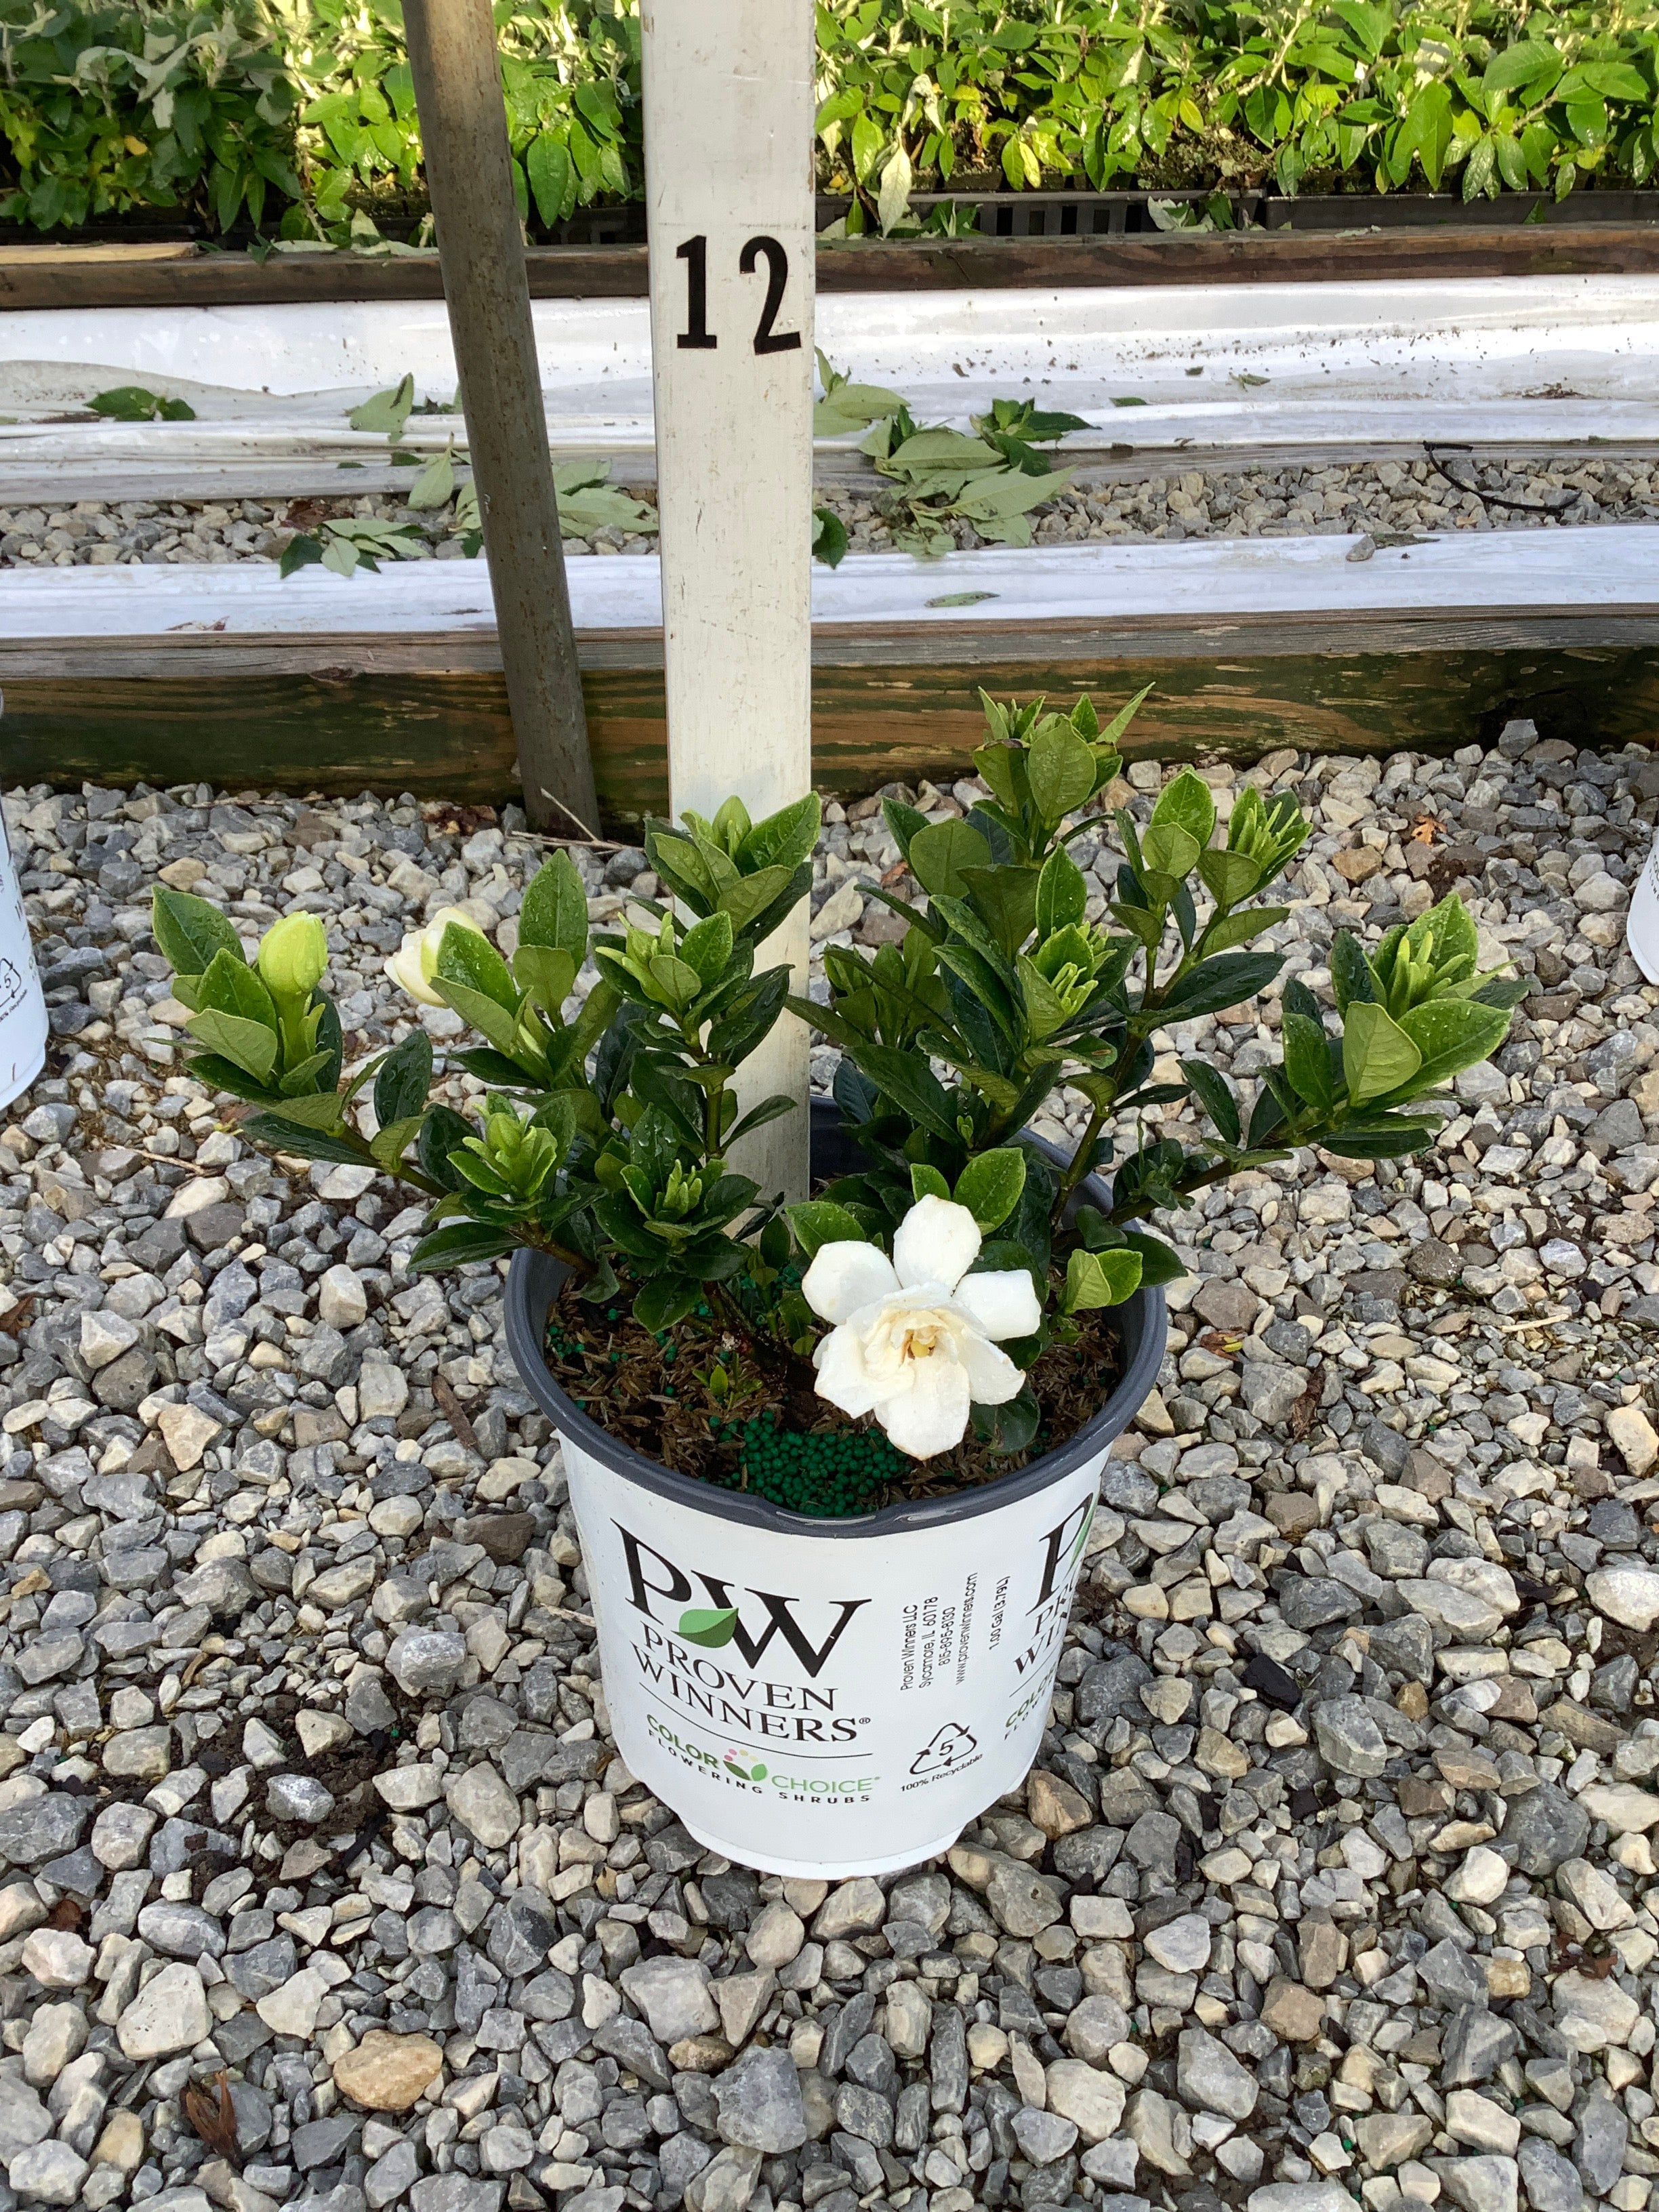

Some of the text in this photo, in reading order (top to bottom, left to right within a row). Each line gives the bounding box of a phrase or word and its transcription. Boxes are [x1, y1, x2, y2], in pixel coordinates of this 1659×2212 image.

[676, 234, 802, 356] 12
[922, 1597, 938, 1626] 60178
[938, 1606, 956, 1666] 815-895-8130
[989, 1576, 1010, 1650] 1.00 Gal (3.79L)
[640, 1620, 838, 1711] PROVEN
[900, 1604, 918, 1692] Proven Winners LLC
[918, 1639, 936, 1689] Sycamore,
[1006, 1662, 1056, 1727] COLO
[647, 1714, 720, 1769] COLOR
[649, 1729, 870, 1804] FLOWERING SHRUBS
[938, 1738, 954, 1757] 5
[900, 1753, 984, 1793] 100% Recyclable
